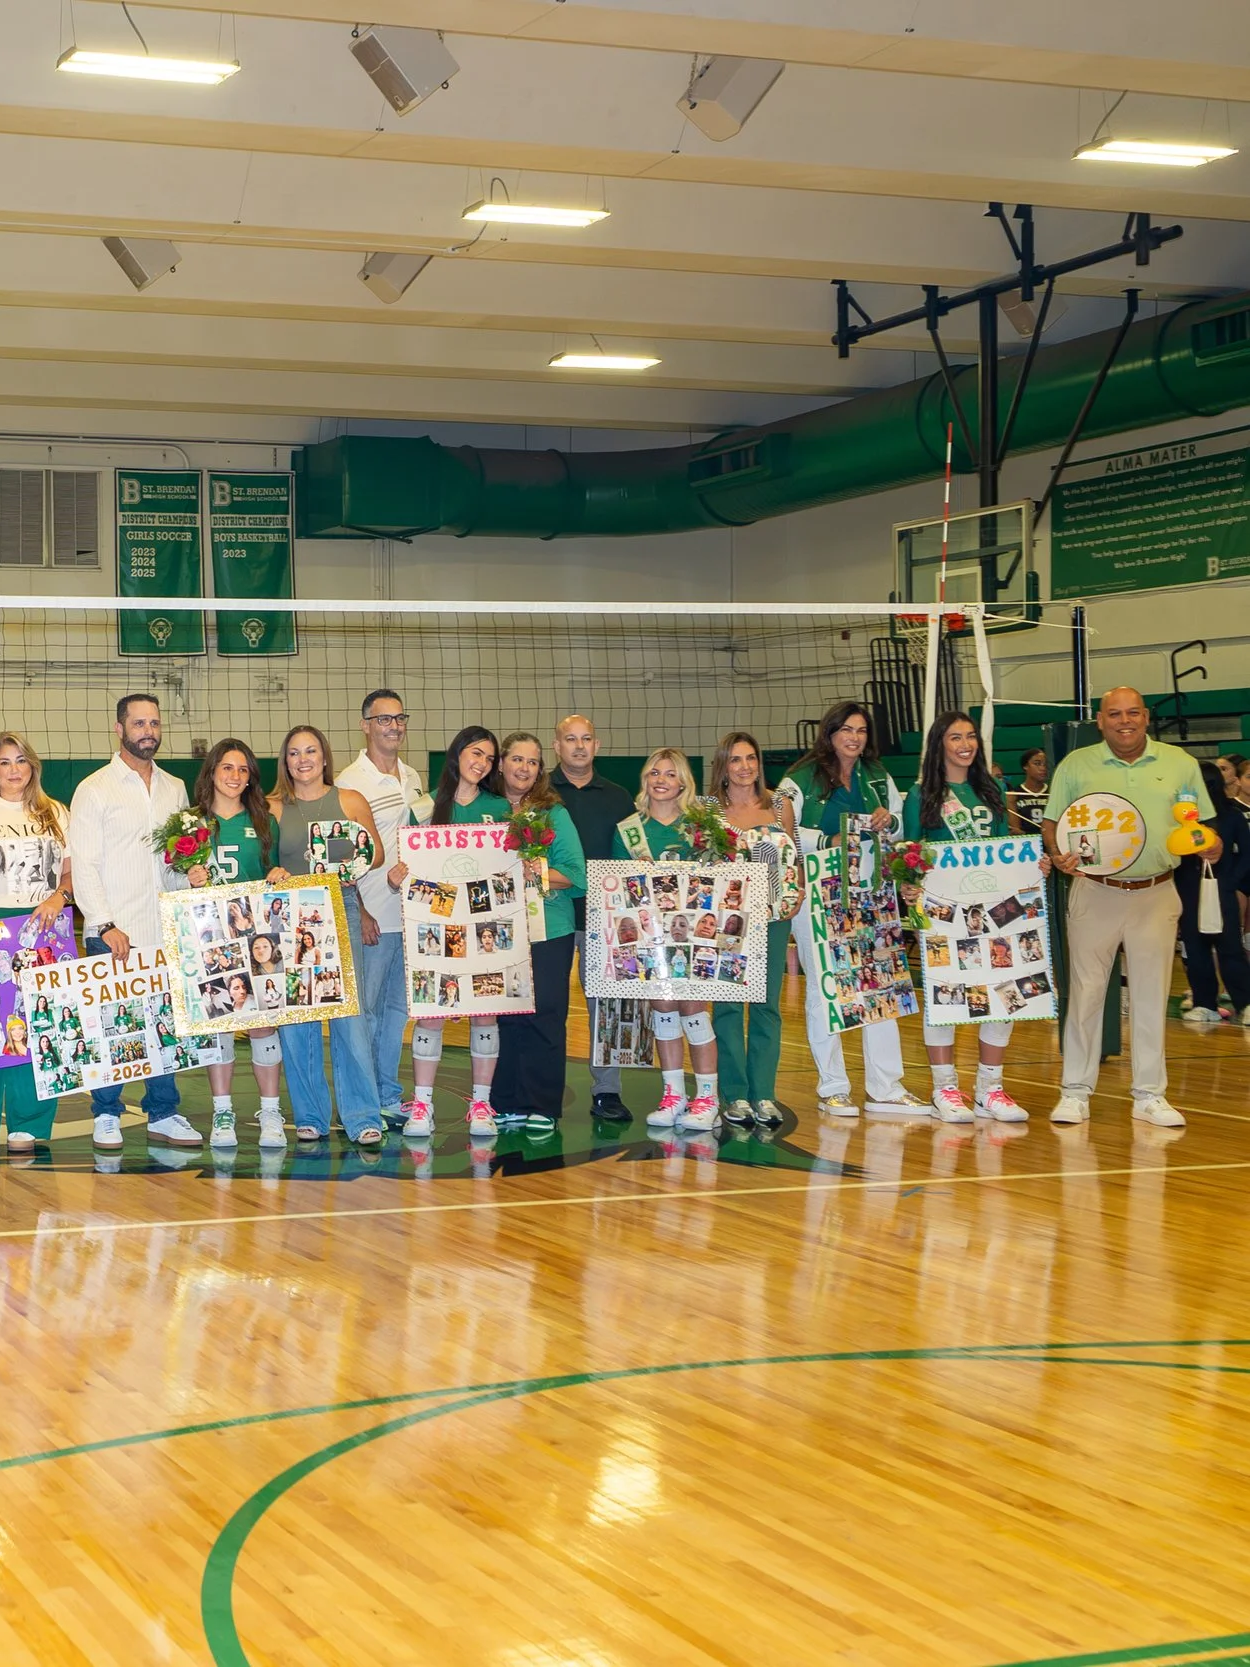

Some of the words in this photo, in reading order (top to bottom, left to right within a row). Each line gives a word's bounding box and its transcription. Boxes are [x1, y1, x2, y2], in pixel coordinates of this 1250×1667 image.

[1105, 453, 1143, 474] ALMA
[1150, 443, 1198, 465] MATER
[121, 479, 141, 504] B
[157, 486, 197, 494] BRENDAN
[212, 480, 232, 507] B
[247, 488, 287, 496] BRENDAN
[122, 514, 156, 524] DISTRICT
[158, 515, 197, 525] CHAMPIONS
[213, 516, 246, 526] DISTRICT
[248, 516, 288, 526] CHAMPIONS
[126, 531, 155, 541] GIRLS
[156, 532, 193, 541] SOCCER
[214, 533, 236, 543] BOYS
[237, 533, 288, 543] BASKETBALL
[131, 548, 156, 556] 2023
[222, 550, 247, 558] 2023
[131, 557, 156, 566] 2024
[1207, 557, 1220, 577] B
[131, 568, 156, 577] 2025
[1066, 804, 1138, 834] #22
[407, 830, 505, 850] CRISTY
[217, 844, 240, 880] 5
[933, 841, 1038, 869] ANICA
[806, 853, 846, 1033] DANICA
[35, 948, 168, 992] PRISCILLA
